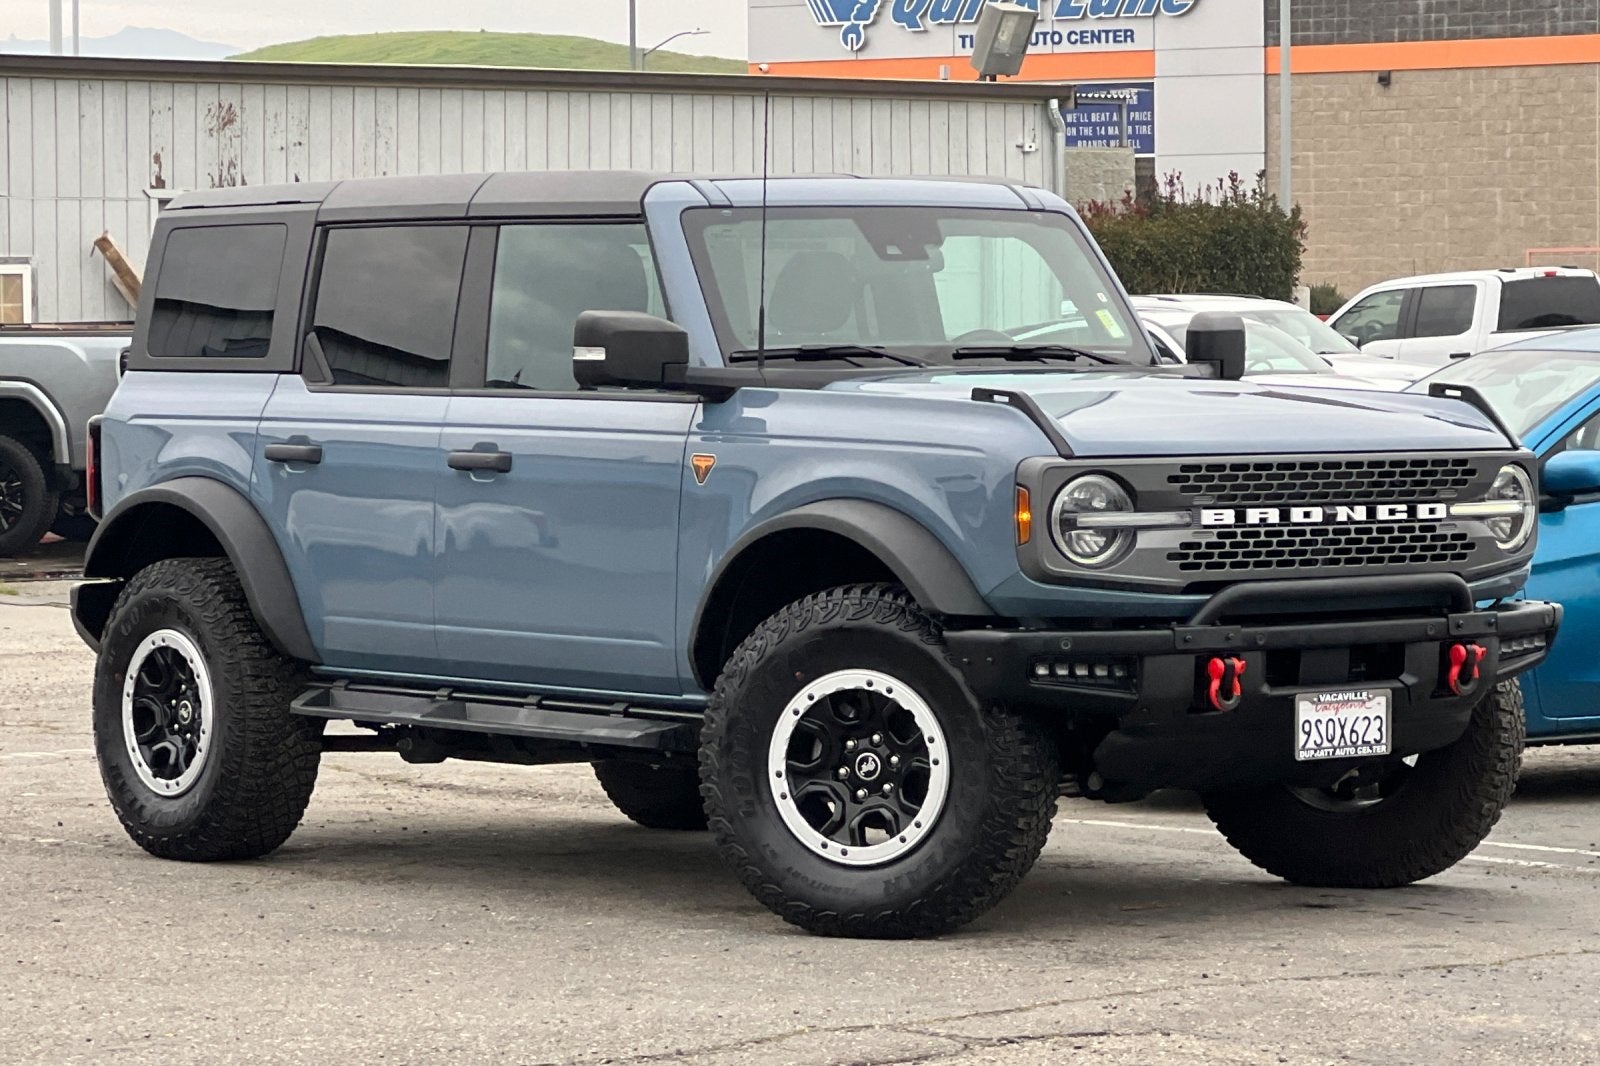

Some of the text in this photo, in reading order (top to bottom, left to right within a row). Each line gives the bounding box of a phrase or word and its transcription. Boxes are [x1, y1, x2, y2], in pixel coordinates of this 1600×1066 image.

[1028, 30, 1063, 46] UTO
[1066, 28, 1135, 45] CENTER
[1066, 112, 1088, 123] WE'LL
[1091, 111, 1110, 122] BEAT
[1130, 111, 1152, 121] PRICE
[1066, 125, 1152, 137] ON THE 14 MAR TIRE
[1200, 503, 1448, 526] BRONCO
[1319, 691, 1368, 702] VACAVILLE
[1314, 701, 1373, 716] California
[1301, 715, 1384, 750] 9SQX623
[1335, 746, 1356, 756] AUTO
[1357, 744, 1387, 755] CENTER
